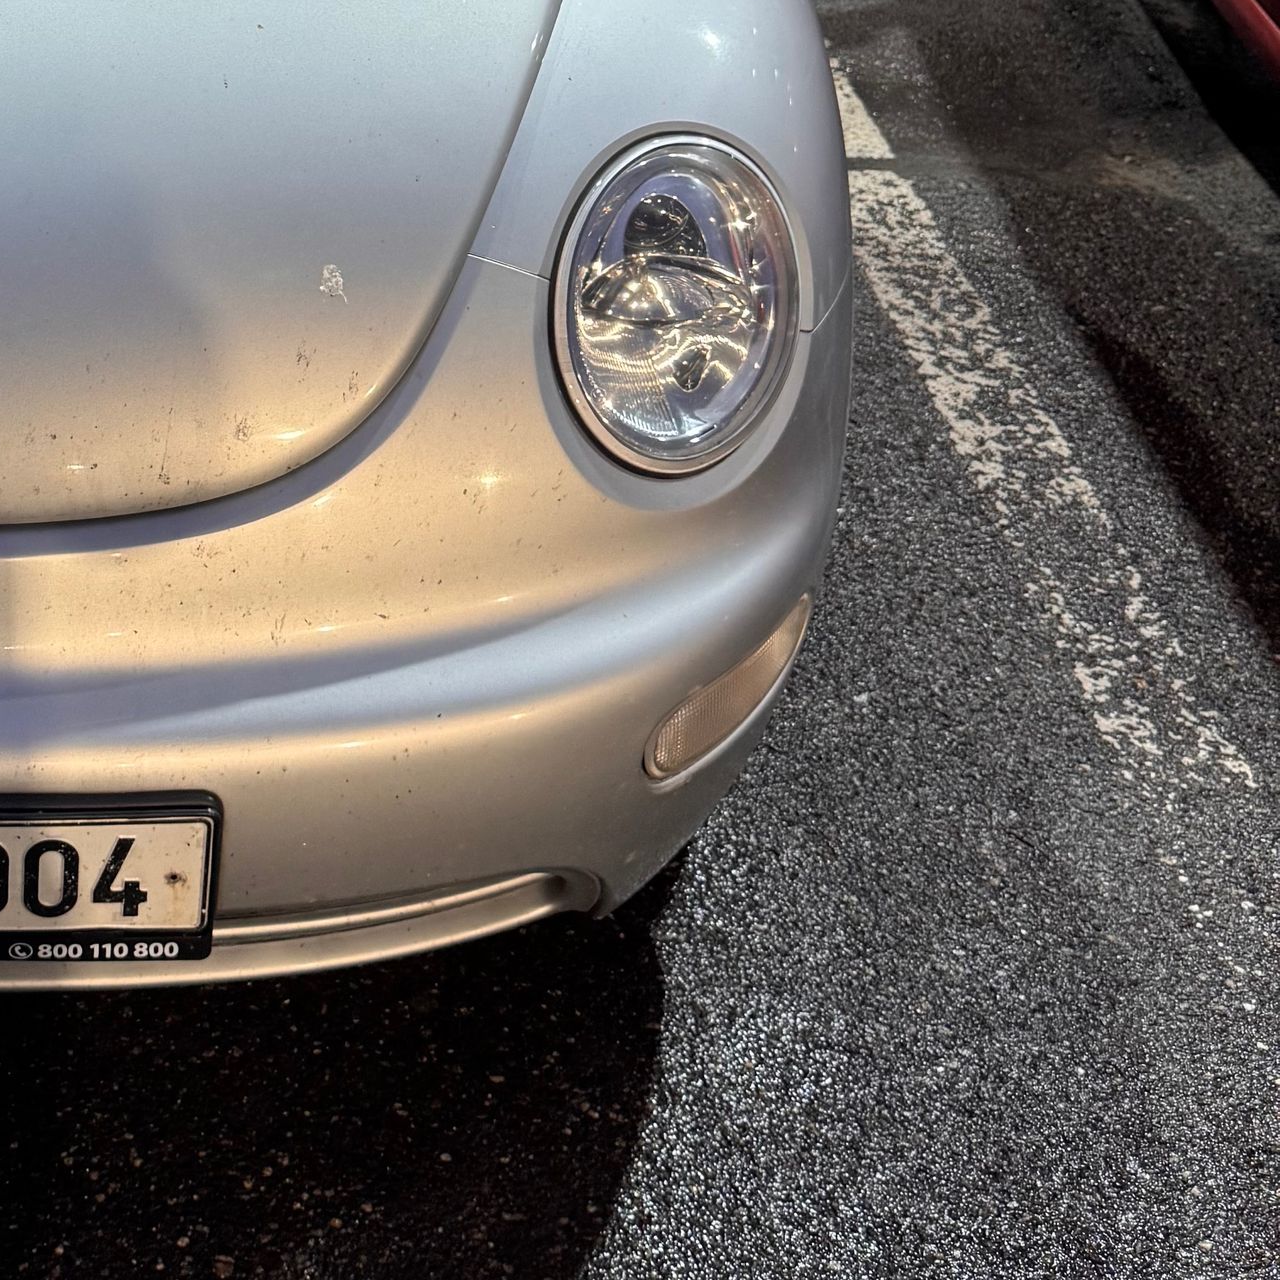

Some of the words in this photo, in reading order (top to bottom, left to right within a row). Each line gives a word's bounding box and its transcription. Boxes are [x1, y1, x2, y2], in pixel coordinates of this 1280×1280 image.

[37, 943, 83, 959] 800
[89, 943, 128, 959] 110
[133, 941, 179, 958] 800
